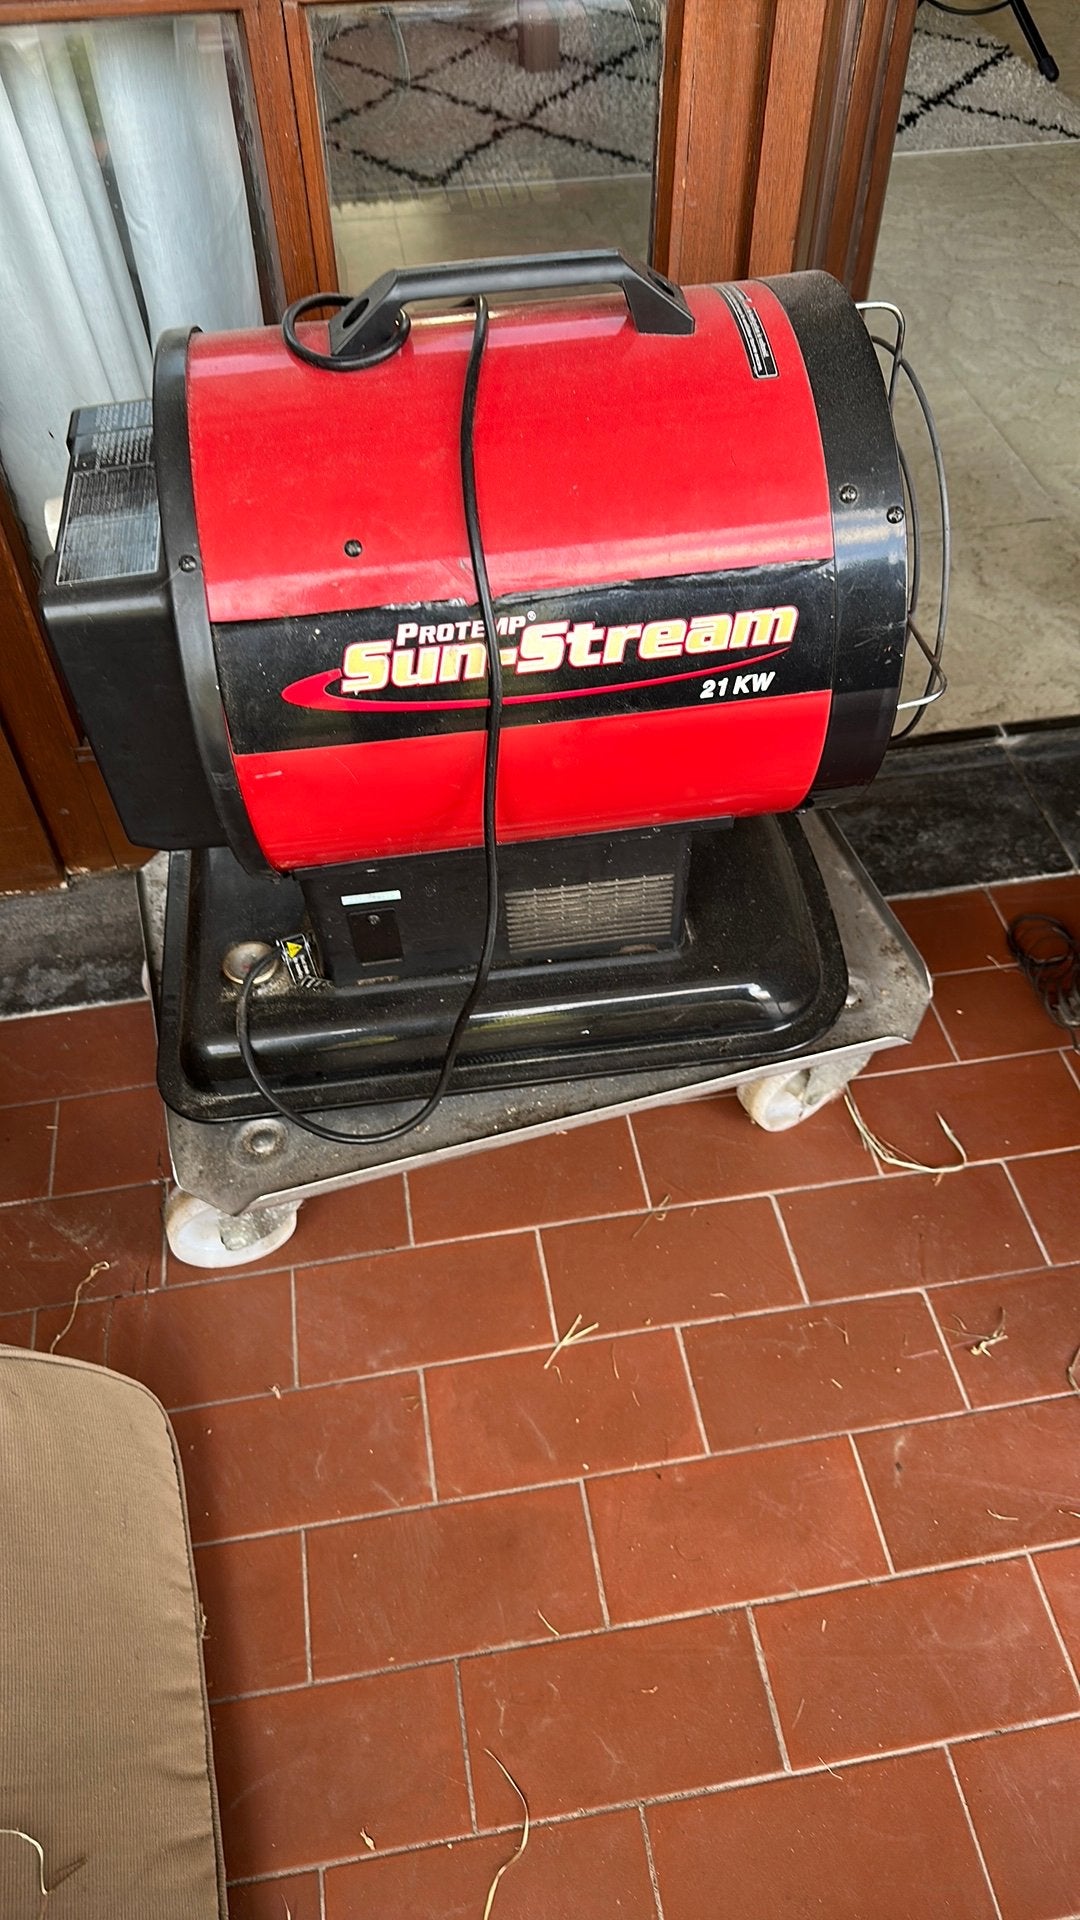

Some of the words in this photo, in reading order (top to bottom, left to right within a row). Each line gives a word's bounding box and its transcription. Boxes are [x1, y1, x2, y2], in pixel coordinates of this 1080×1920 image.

[340, 604, 800, 694] Sun-Stream
[699, 677, 729, 699] 21
[732, 671, 776, 695] KW
